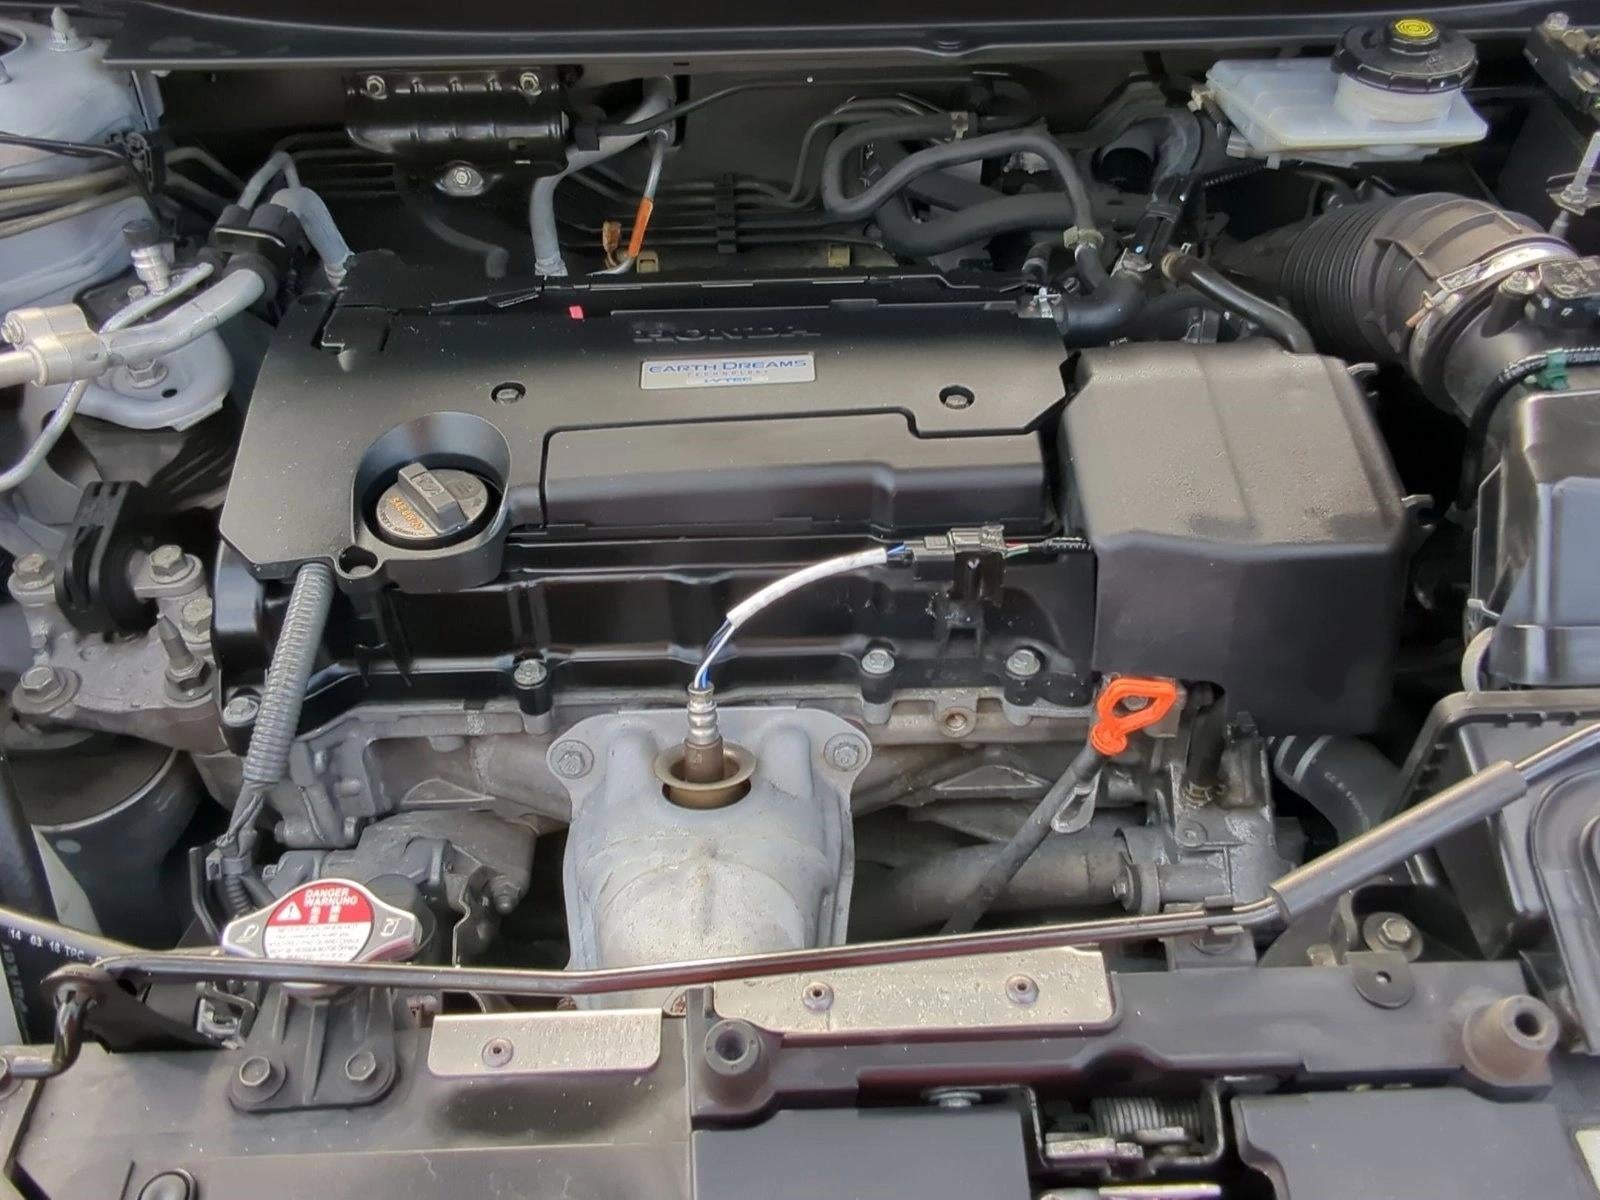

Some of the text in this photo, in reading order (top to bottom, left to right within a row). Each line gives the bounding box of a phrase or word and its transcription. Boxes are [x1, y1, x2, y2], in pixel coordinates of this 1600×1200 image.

[649, 359, 807, 373] EARTH DREAMS
[304, 888, 350, 898] DANGER
